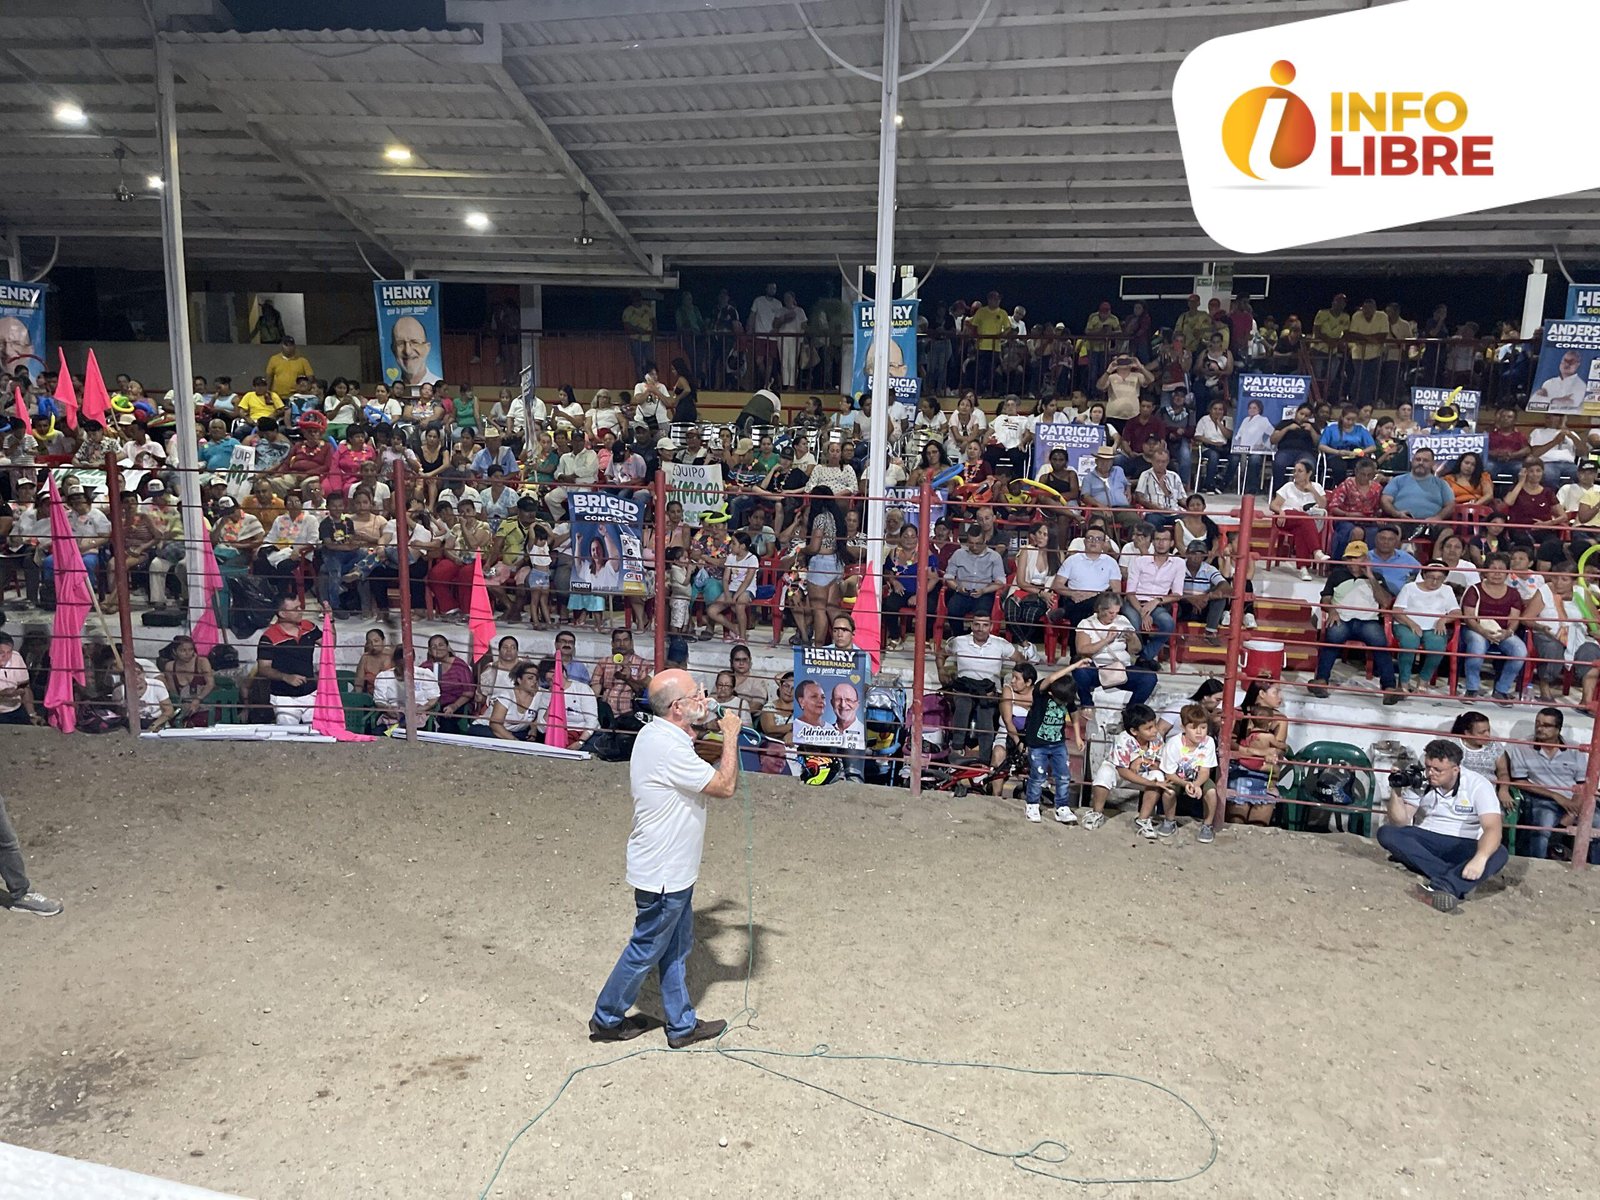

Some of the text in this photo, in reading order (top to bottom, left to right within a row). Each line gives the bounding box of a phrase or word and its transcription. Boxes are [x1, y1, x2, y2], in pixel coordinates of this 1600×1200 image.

[0, 286, 40, 302] ENRY
[382, 286, 431, 299] HENRY
[862, 305, 912, 320] HRY
[1548, 324, 1600, 336] ANDERS
[1547, 335, 1600, 343] GIRALD
[868, 375, 918, 388] PRICIA
[1244, 376, 1306, 387] PATRICIA
[1243, 385, 1305, 394] VELASQUEZ
[1415, 390, 1439, 400] DON
[1040, 424, 1099, 437] PATRICIA
[1039, 434, 1099, 443] VELASQUEZ
[1412, 436, 1484, 448] ANDERSON
[673, 464, 706, 478] EQUIPO
[573, 494, 639, 515] BRIGID
[574, 506, 638, 521] PULIDO
[804, 648, 856, 662] HENRY
[813, 660, 855, 668] GOBERNADOR
[800, 727, 838, 737] Adriana
